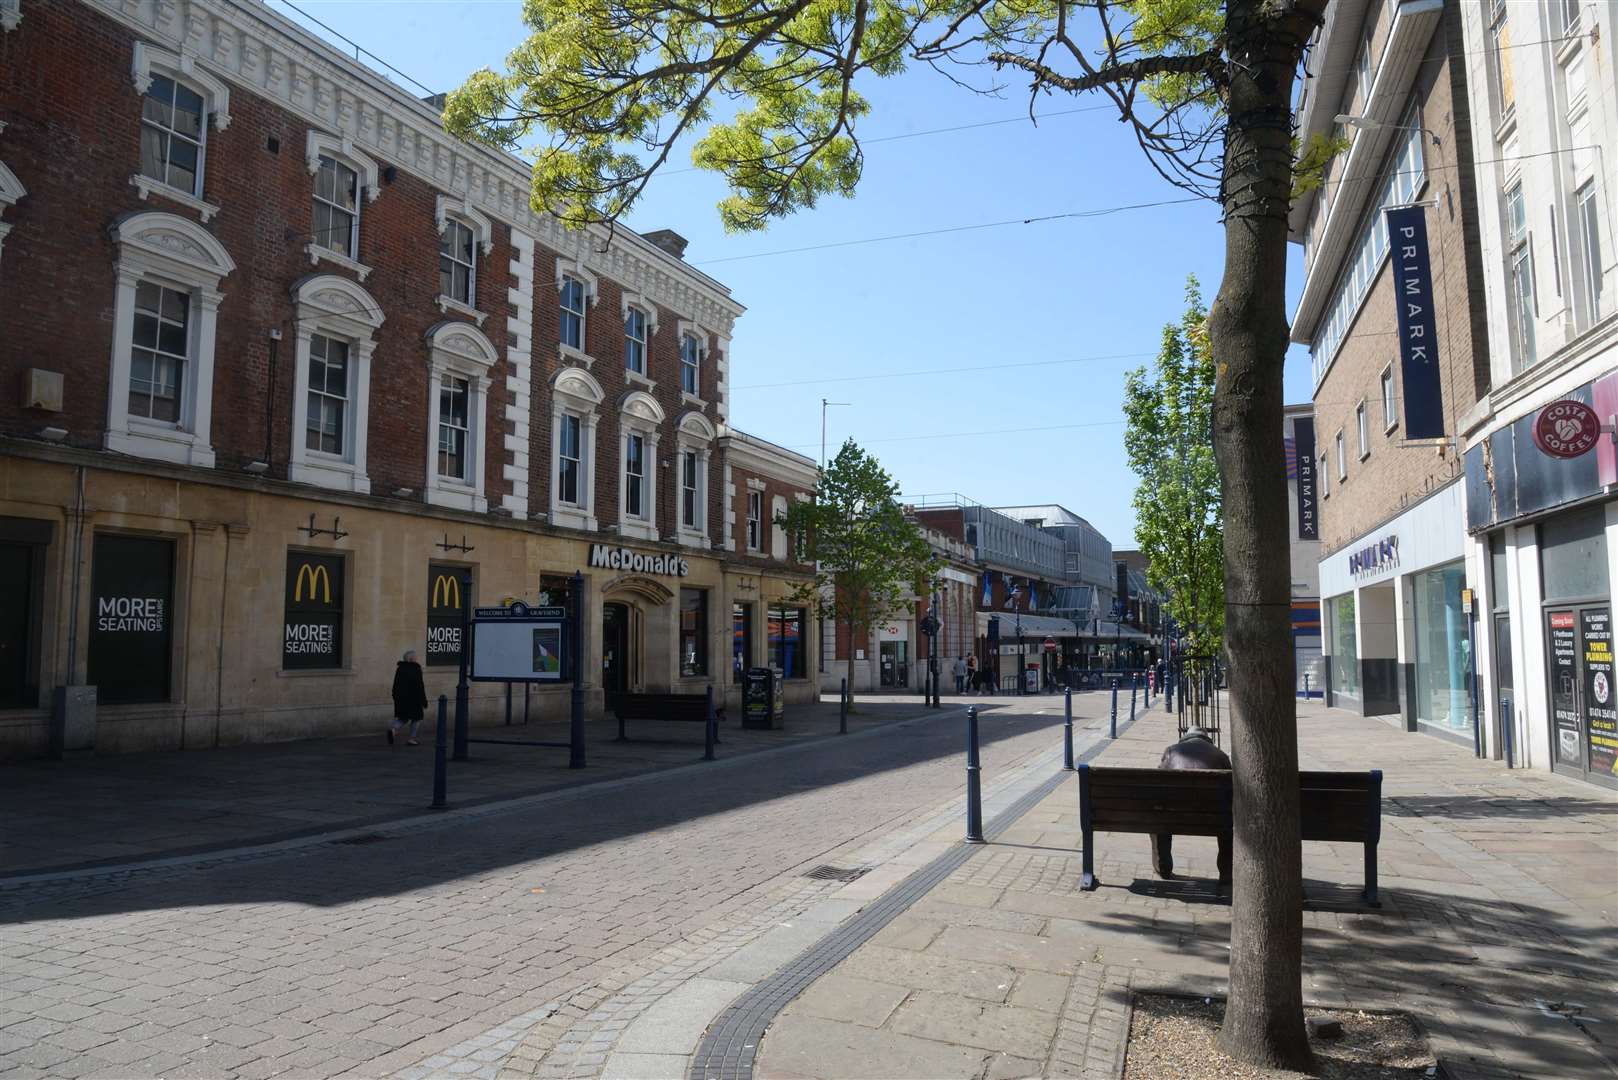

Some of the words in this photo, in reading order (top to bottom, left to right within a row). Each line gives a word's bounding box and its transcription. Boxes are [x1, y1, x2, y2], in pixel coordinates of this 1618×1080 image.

[1400, 226, 1426, 361] PRIMARK
[1547, 406, 1587, 420] COSTA
[1545, 433, 1592, 452] COFFEE
[1302, 456, 1313, 532] PRIMARK
[592, 543, 688, 577] McDonald's
[99, 597, 157, 617] MORE
[98, 617, 156, 632] SEATING
[285, 624, 328, 641] MORE
[428, 627, 461, 642] MORE
[285, 641, 328, 653] SEATING
[427, 642, 460, 653] SEATING
[1589, 642, 1608, 652] TOWER
[1585, 652, 1613, 662] PLUMBING
